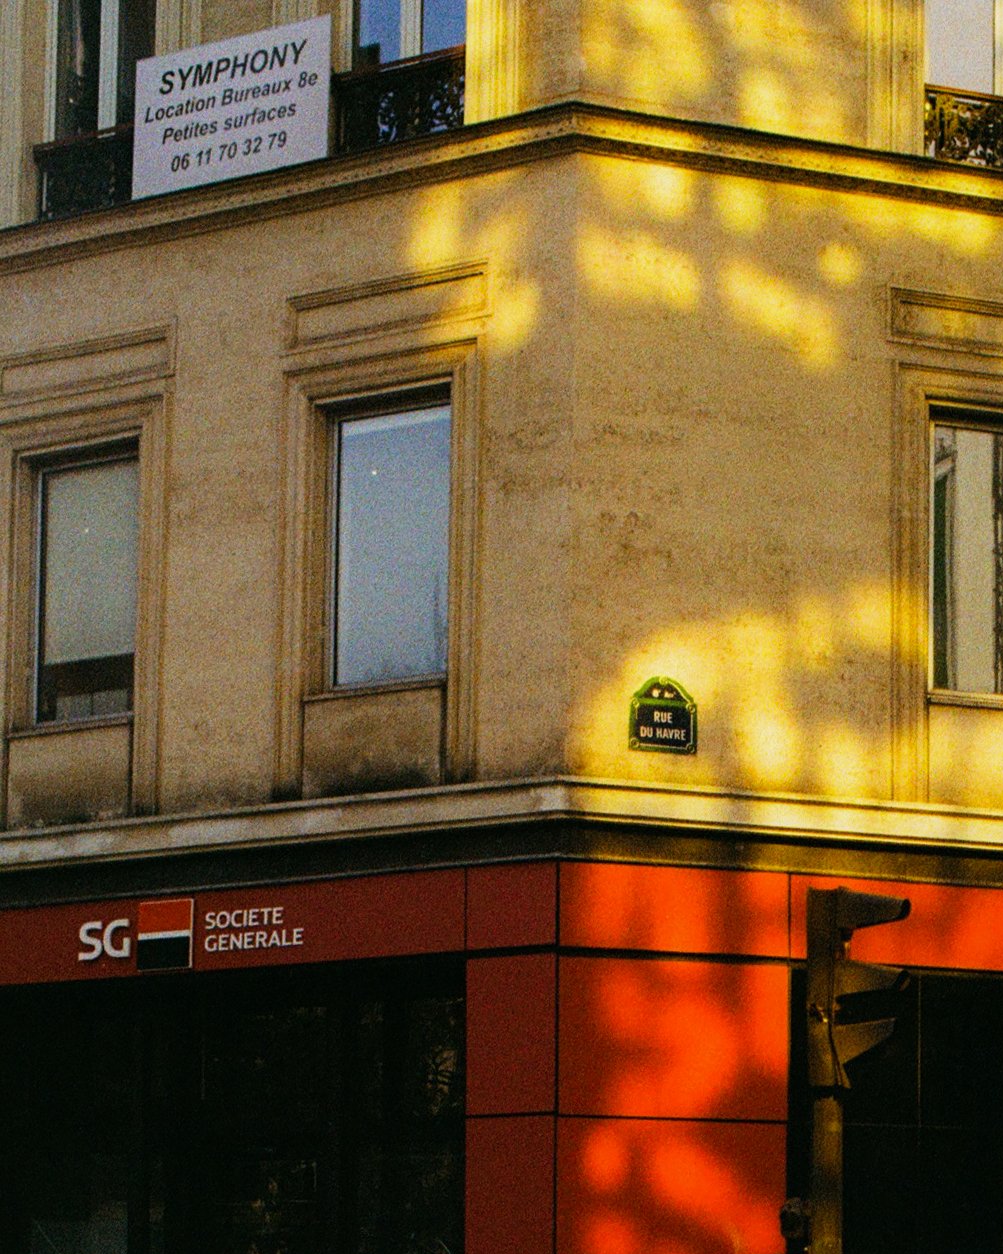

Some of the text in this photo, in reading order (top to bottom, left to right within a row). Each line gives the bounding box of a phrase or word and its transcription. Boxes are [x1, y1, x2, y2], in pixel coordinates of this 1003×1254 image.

[158, 38, 308, 96] SYMPHONY
[144, 71, 319, 124] Location Bureaux 8e
[161, 102, 297, 145] Petites surfaces
[170, 130, 288, 173] 06 11 70 32 79
[640, 725, 687, 741] DU HAVRE
[653, 710, 673, 724] RUE
[204, 906, 285, 930] SOCIETE
[78, 918, 131, 962] SG
[204, 927, 305, 953] GENERALE
